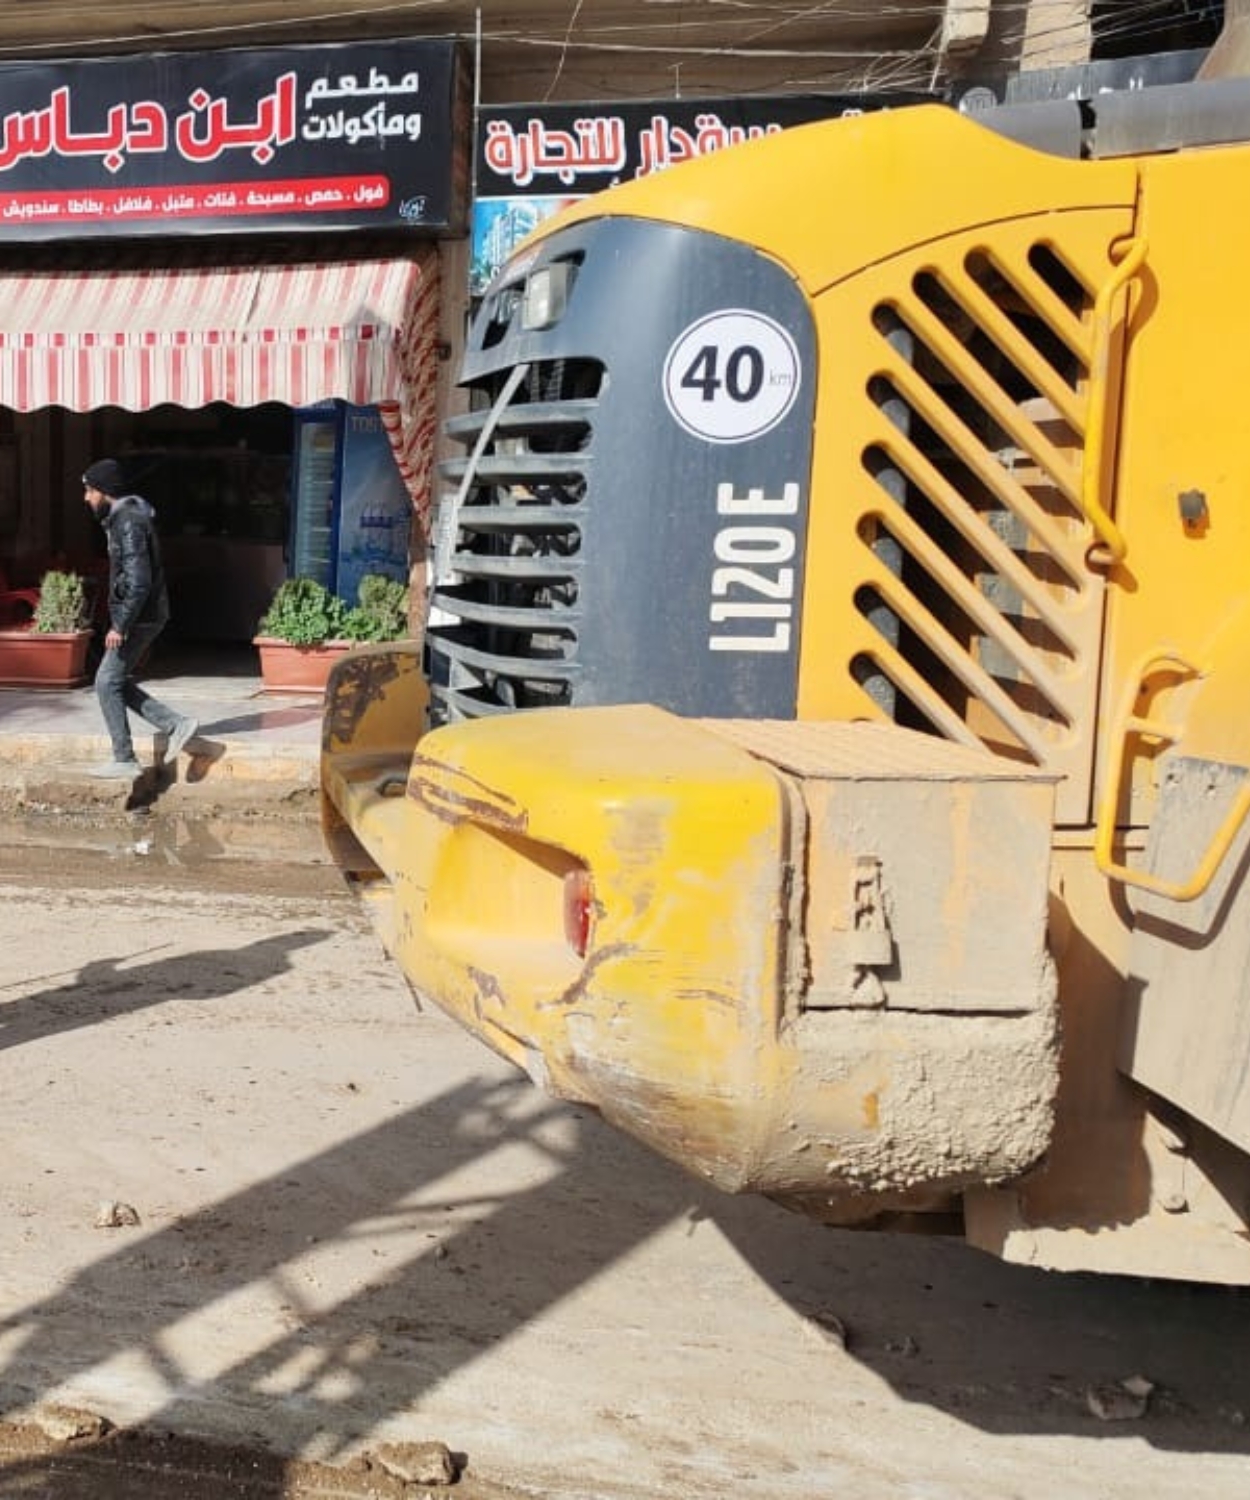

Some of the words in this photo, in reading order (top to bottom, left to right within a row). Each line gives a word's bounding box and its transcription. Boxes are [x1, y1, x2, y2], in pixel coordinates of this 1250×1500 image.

[305, 67, 419, 108] مطعم
[175, 71, 298, 164] ابن
[301, 102, 421, 143] ومأكولات
[485, 116, 625, 186] للتجارة
[2, 199, 59, 220] سندويش
[67, 198, 104, 216] بطاطا
[113, 195, 153, 215] فلافل
[304, 188, 344, 206] حمص
[352, 184, 384, 203] فول
[681, 345, 764, 403] 40
[770, 367, 794, 386] km
[717, 482, 800, 515] E
